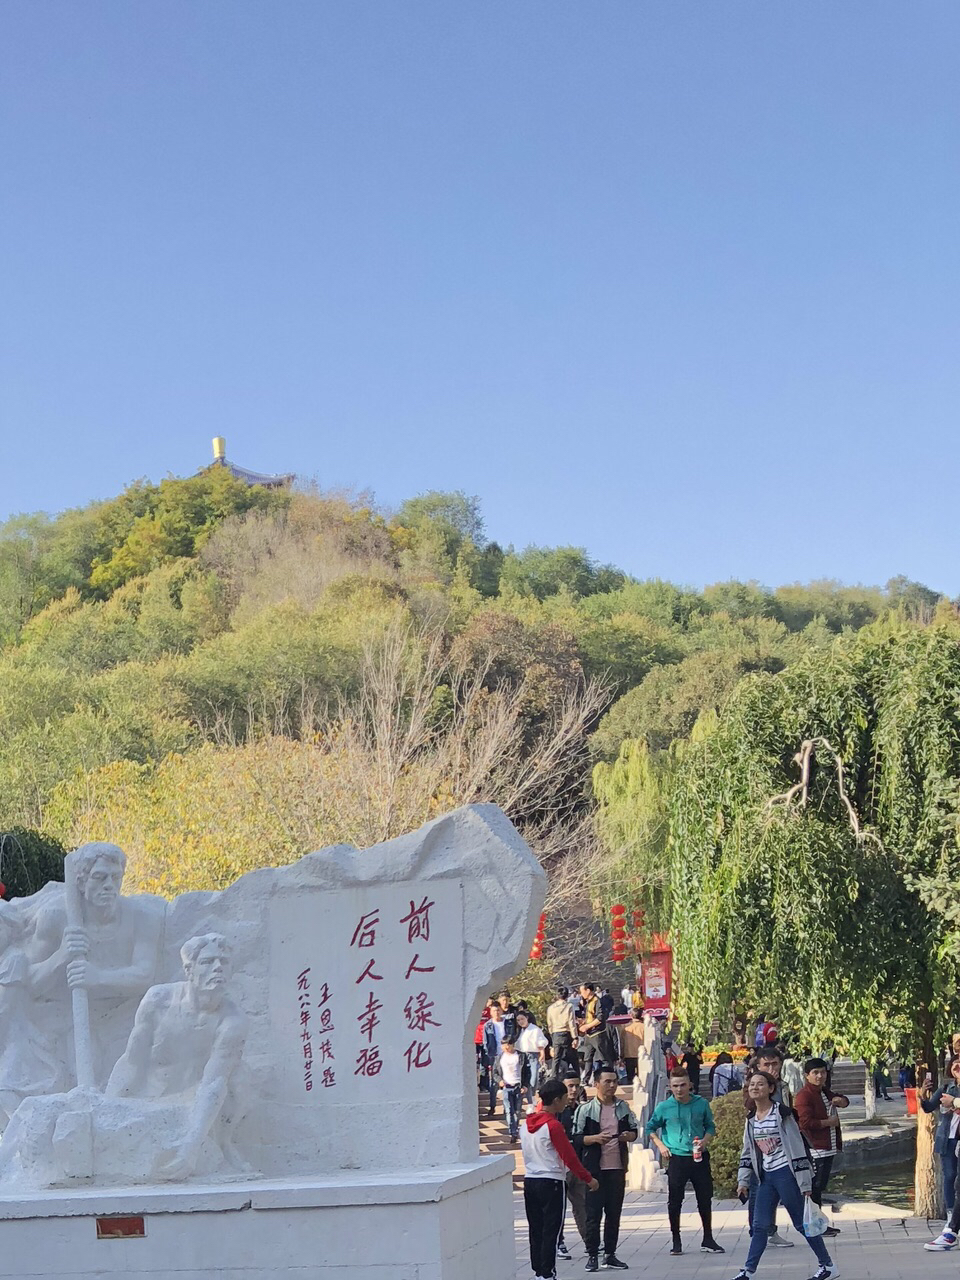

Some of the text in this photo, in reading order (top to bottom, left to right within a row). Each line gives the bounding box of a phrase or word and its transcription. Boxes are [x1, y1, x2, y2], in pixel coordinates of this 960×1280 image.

[350, 908, 384, 1076] 后人幸福
[399, 896, 442, 1072] 前人绿化
